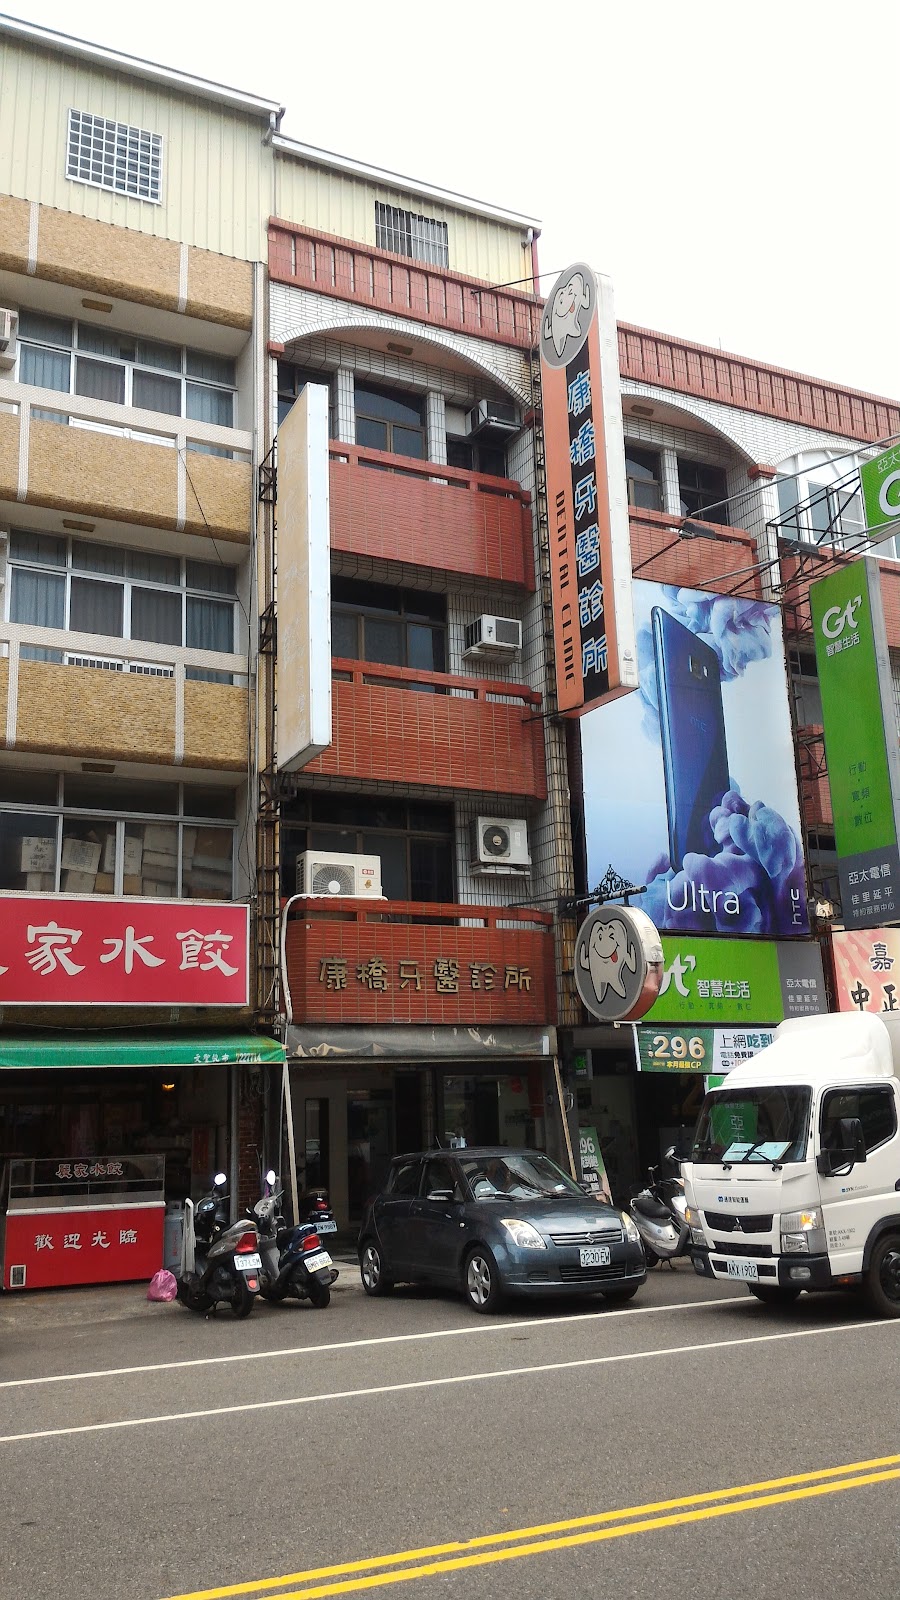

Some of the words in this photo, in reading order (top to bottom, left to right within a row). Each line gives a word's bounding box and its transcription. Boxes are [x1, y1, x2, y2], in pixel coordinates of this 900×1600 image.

[568, 369, 609, 677] 康橋牙醫診所
[826, 631, 860, 657] 智慧生活
[848, 863, 891, 885] 亞太電信
[666, 880, 740, 915] Ultra
[851, 886, 893, 905] 佳里延平
[852, 902, 895, 917] 特約服務中心
[0, 920, 239, 977] 家水餃
[869, 943, 894, 970] 嘉
[319, 957, 532, 993] 康橋牙醫診所
[786, 978, 817, 988] 亞太電信
[697, 979, 750, 998] 智慧生活
[653, 1035, 705, 1059] 296
[34, 1228, 138, 1251] 歡迎光臨
